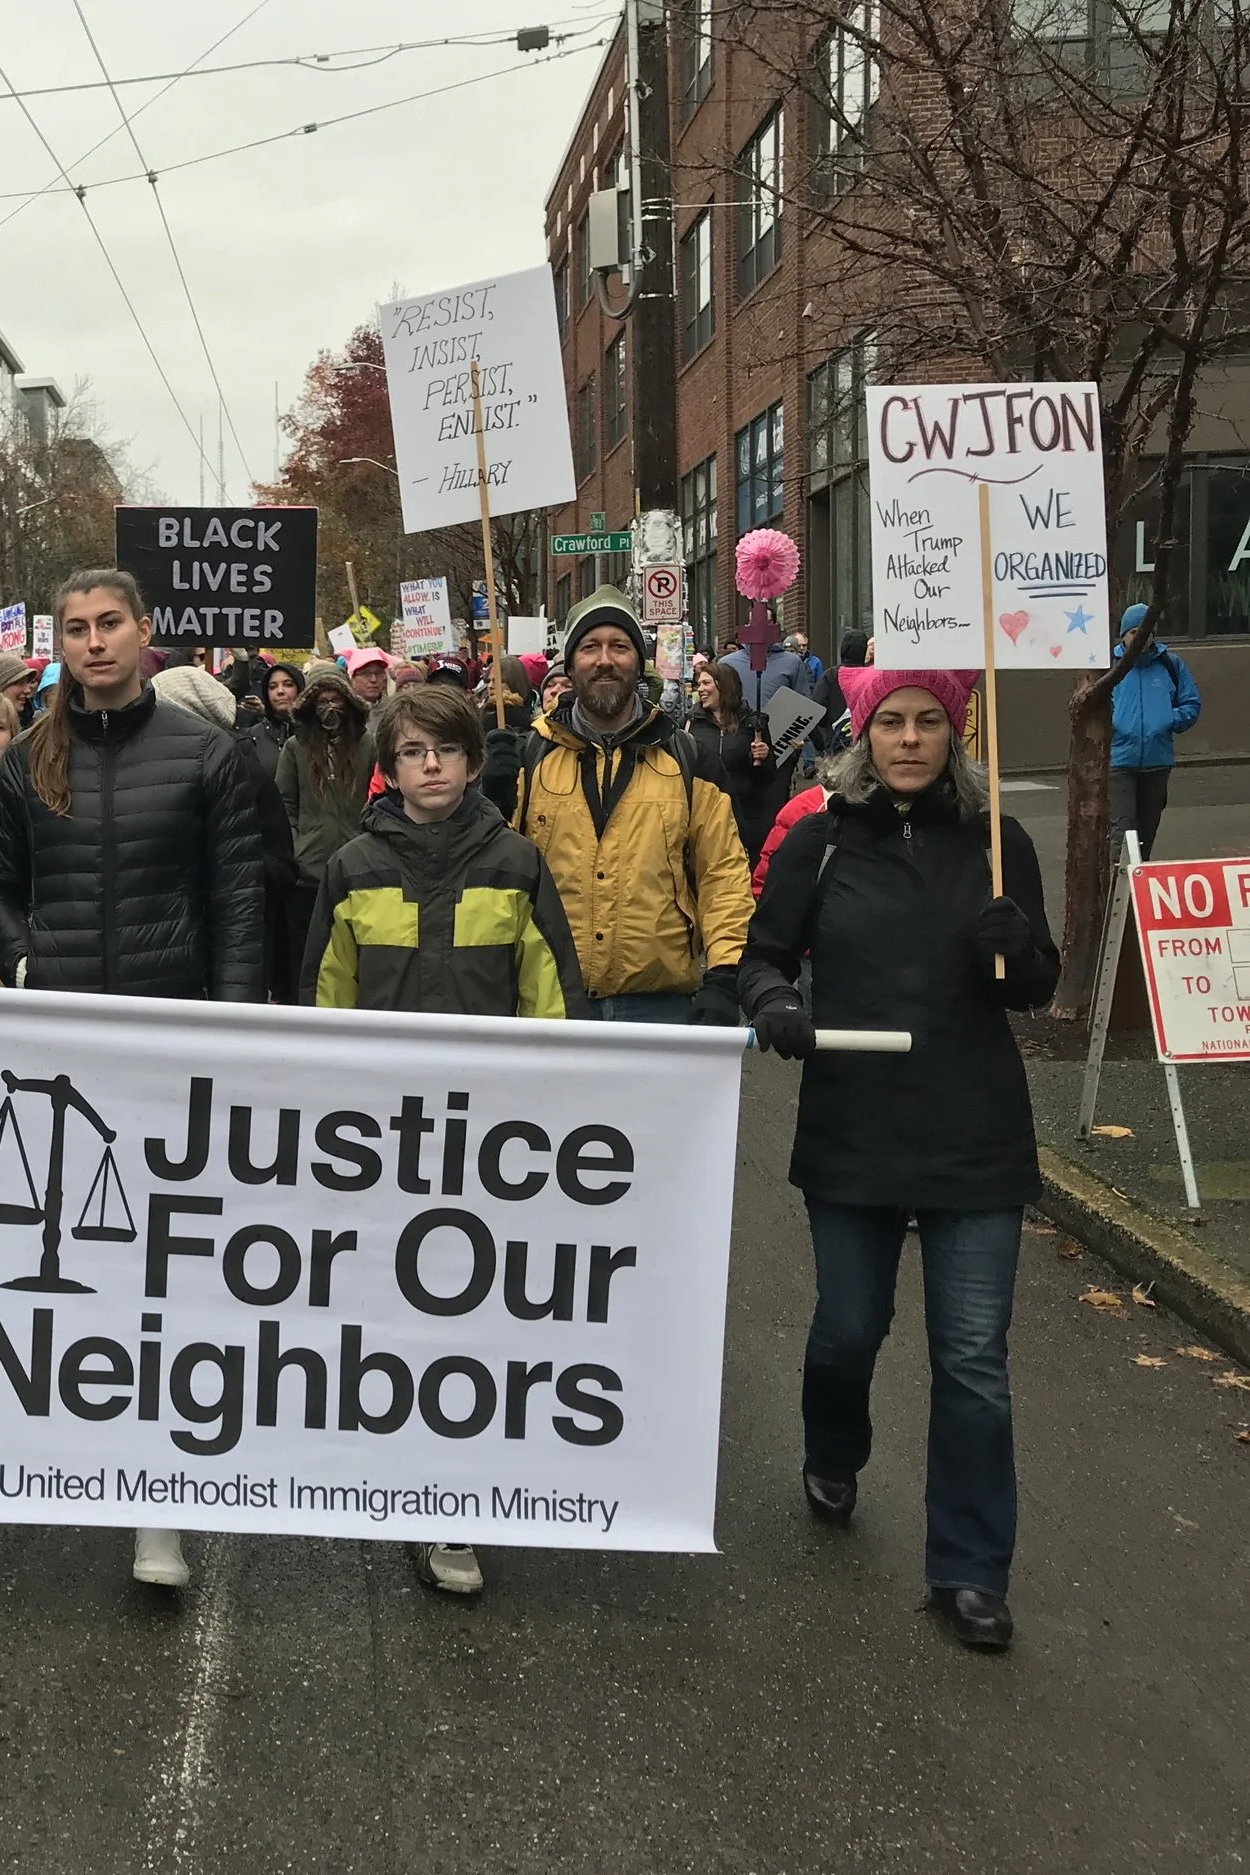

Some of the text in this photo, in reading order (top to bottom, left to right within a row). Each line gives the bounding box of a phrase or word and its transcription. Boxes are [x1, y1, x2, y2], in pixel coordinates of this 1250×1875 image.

[408, 332, 482, 373] INSIST,
[423, 362, 513, 411] PERSIST,
[880, 387, 1095, 463] CWJFON
[437, 460, 512, 494] HILLARY
[876, 499, 931, 528] When
[1019, 488, 1076, 530] WE
[158, 517, 283, 551] BLACK
[554, 536, 611, 552] Crawford
[903, 524, 963, 557] Trump
[172, 560, 273, 593] LIVES
[886, 554, 951, 580] Attacked
[994, 550, 1107, 582] ORGANIZED
[402, 580, 425, 593] WHAT
[913, 578, 951, 600] Our
[405, 605, 426, 616] WHAT
[649, 607, 678, 616] SPACE
[653, 600, 674, 608] THIS
[152, 606, 284, 639] MATTER
[416, 615, 435, 626] WILL
[1148, 874, 1214, 920] NO
[1158, 937, 1223, 957] FROM
[1182, 975, 1211, 994] TO
[1202, 1039, 1250, 1051] NATIONA
[144, 1077, 635, 1206] Justice
[145, 1194, 638, 1324] For Our
[0, 1464, 106, 1502] United
[116, 1468, 278, 1508] Methodist
[290, 1476, 480, 1522] Immigration
[491, 1486, 619, 1533] Ministry
